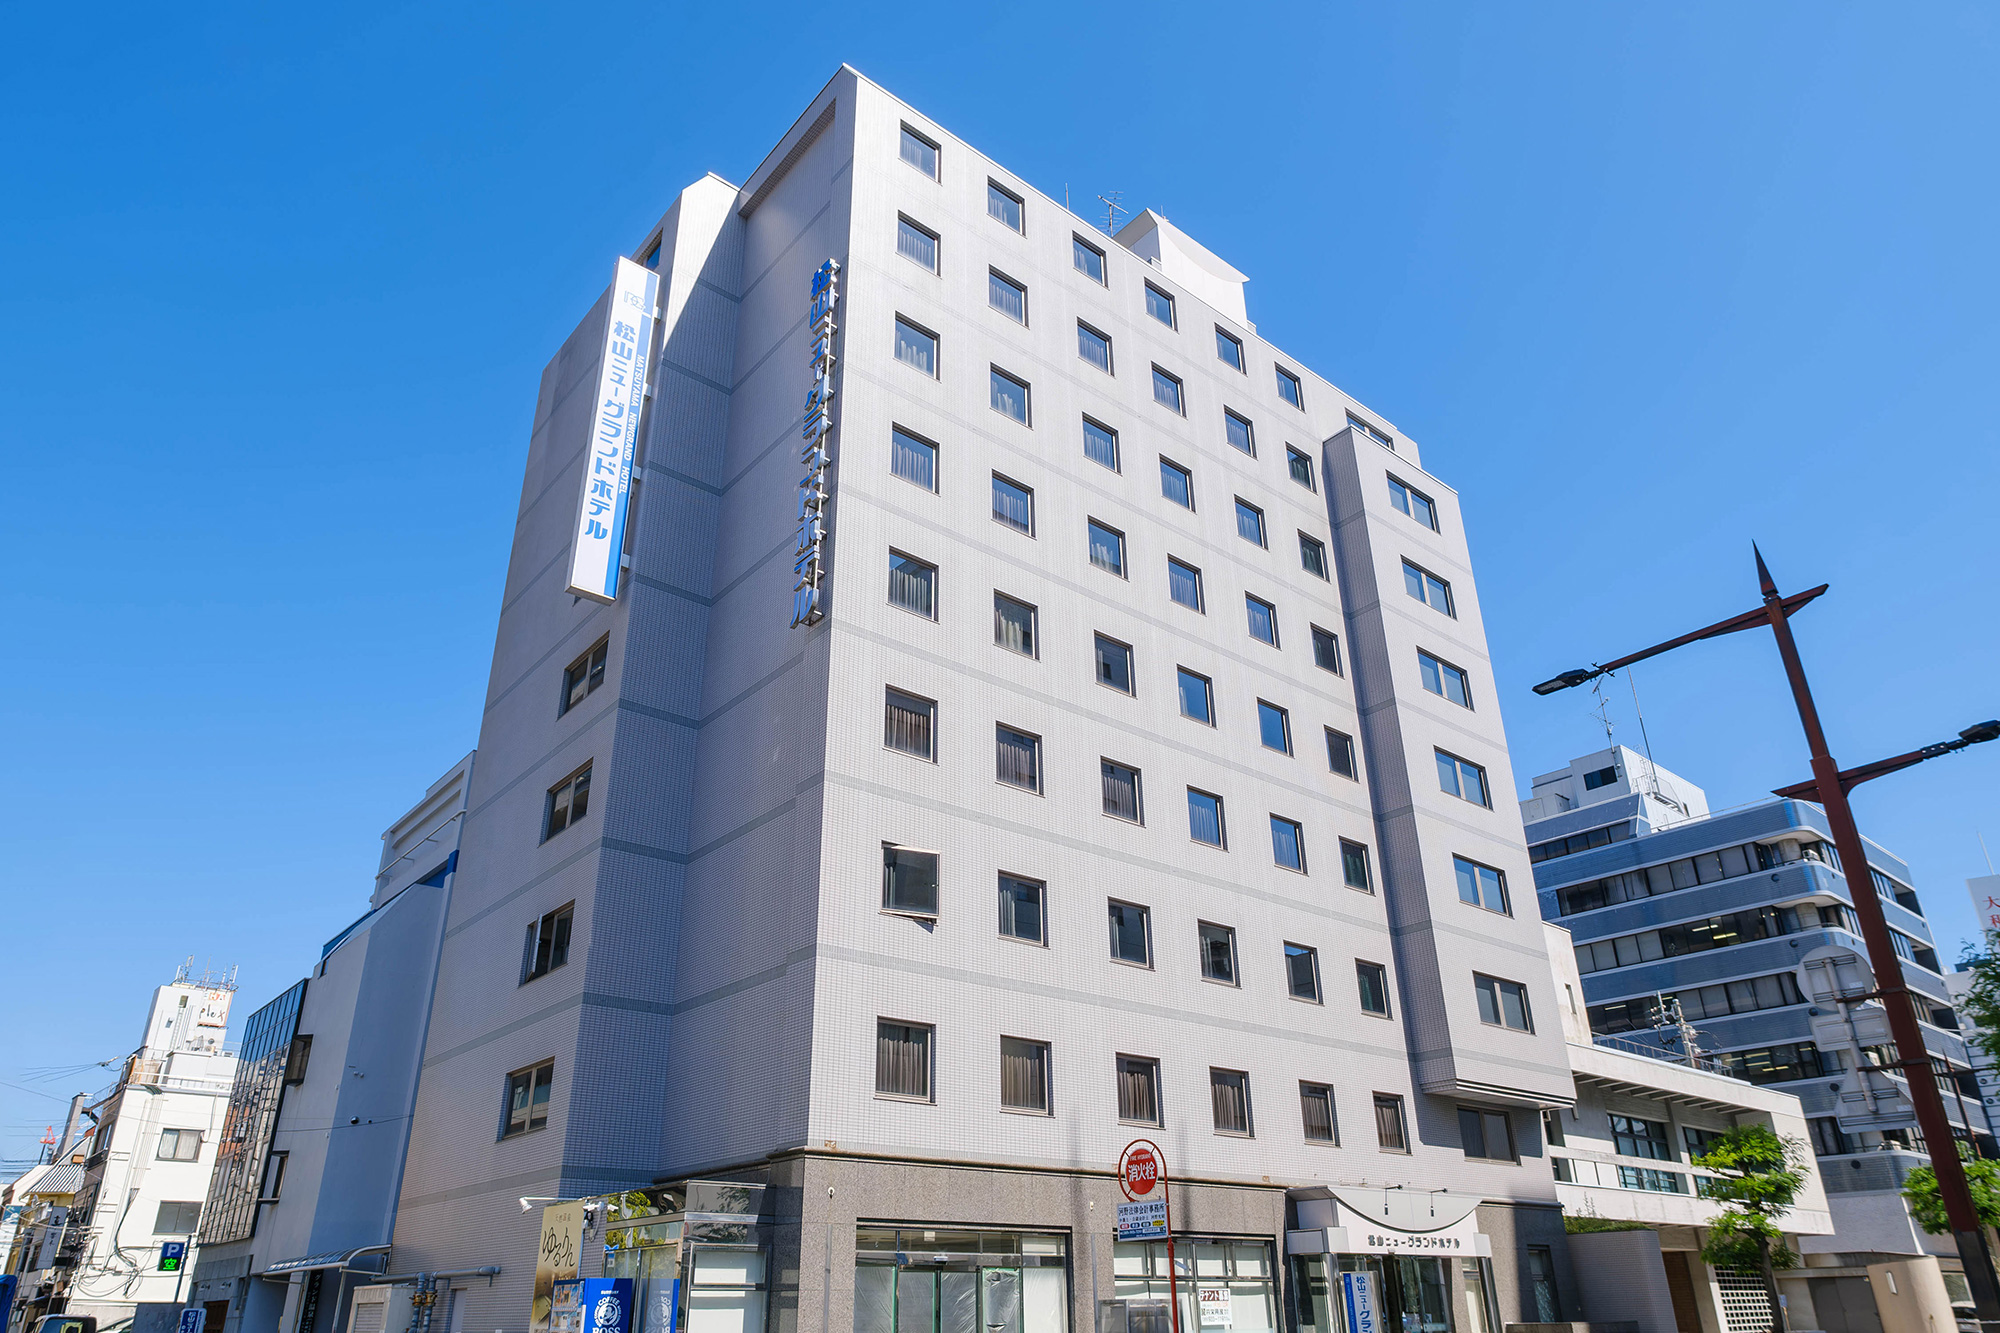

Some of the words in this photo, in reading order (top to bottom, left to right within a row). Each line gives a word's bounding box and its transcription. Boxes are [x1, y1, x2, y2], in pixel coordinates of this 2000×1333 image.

[629, 354, 646, 407] MATSUYAMA
[585, 320, 636, 540] 松山ニューグランドホテル
[623, 412, 638, 461] NEWGRAND
[789, 258, 837, 629] 松山ニューグランドホテル
[618, 465, 631, 494] HOTEL
[1128, 1161, 1155, 1182] 消火栓
[166, 1243, 180, 1257] P
[542, 1227, 575, 1267] ゆるりん
[1367, 1234, 1460, 1249] 松山ニューグランドホテル
[163, 1258, 177, 1270] 空
[598, 1296, 621, 1306] COFFEE
